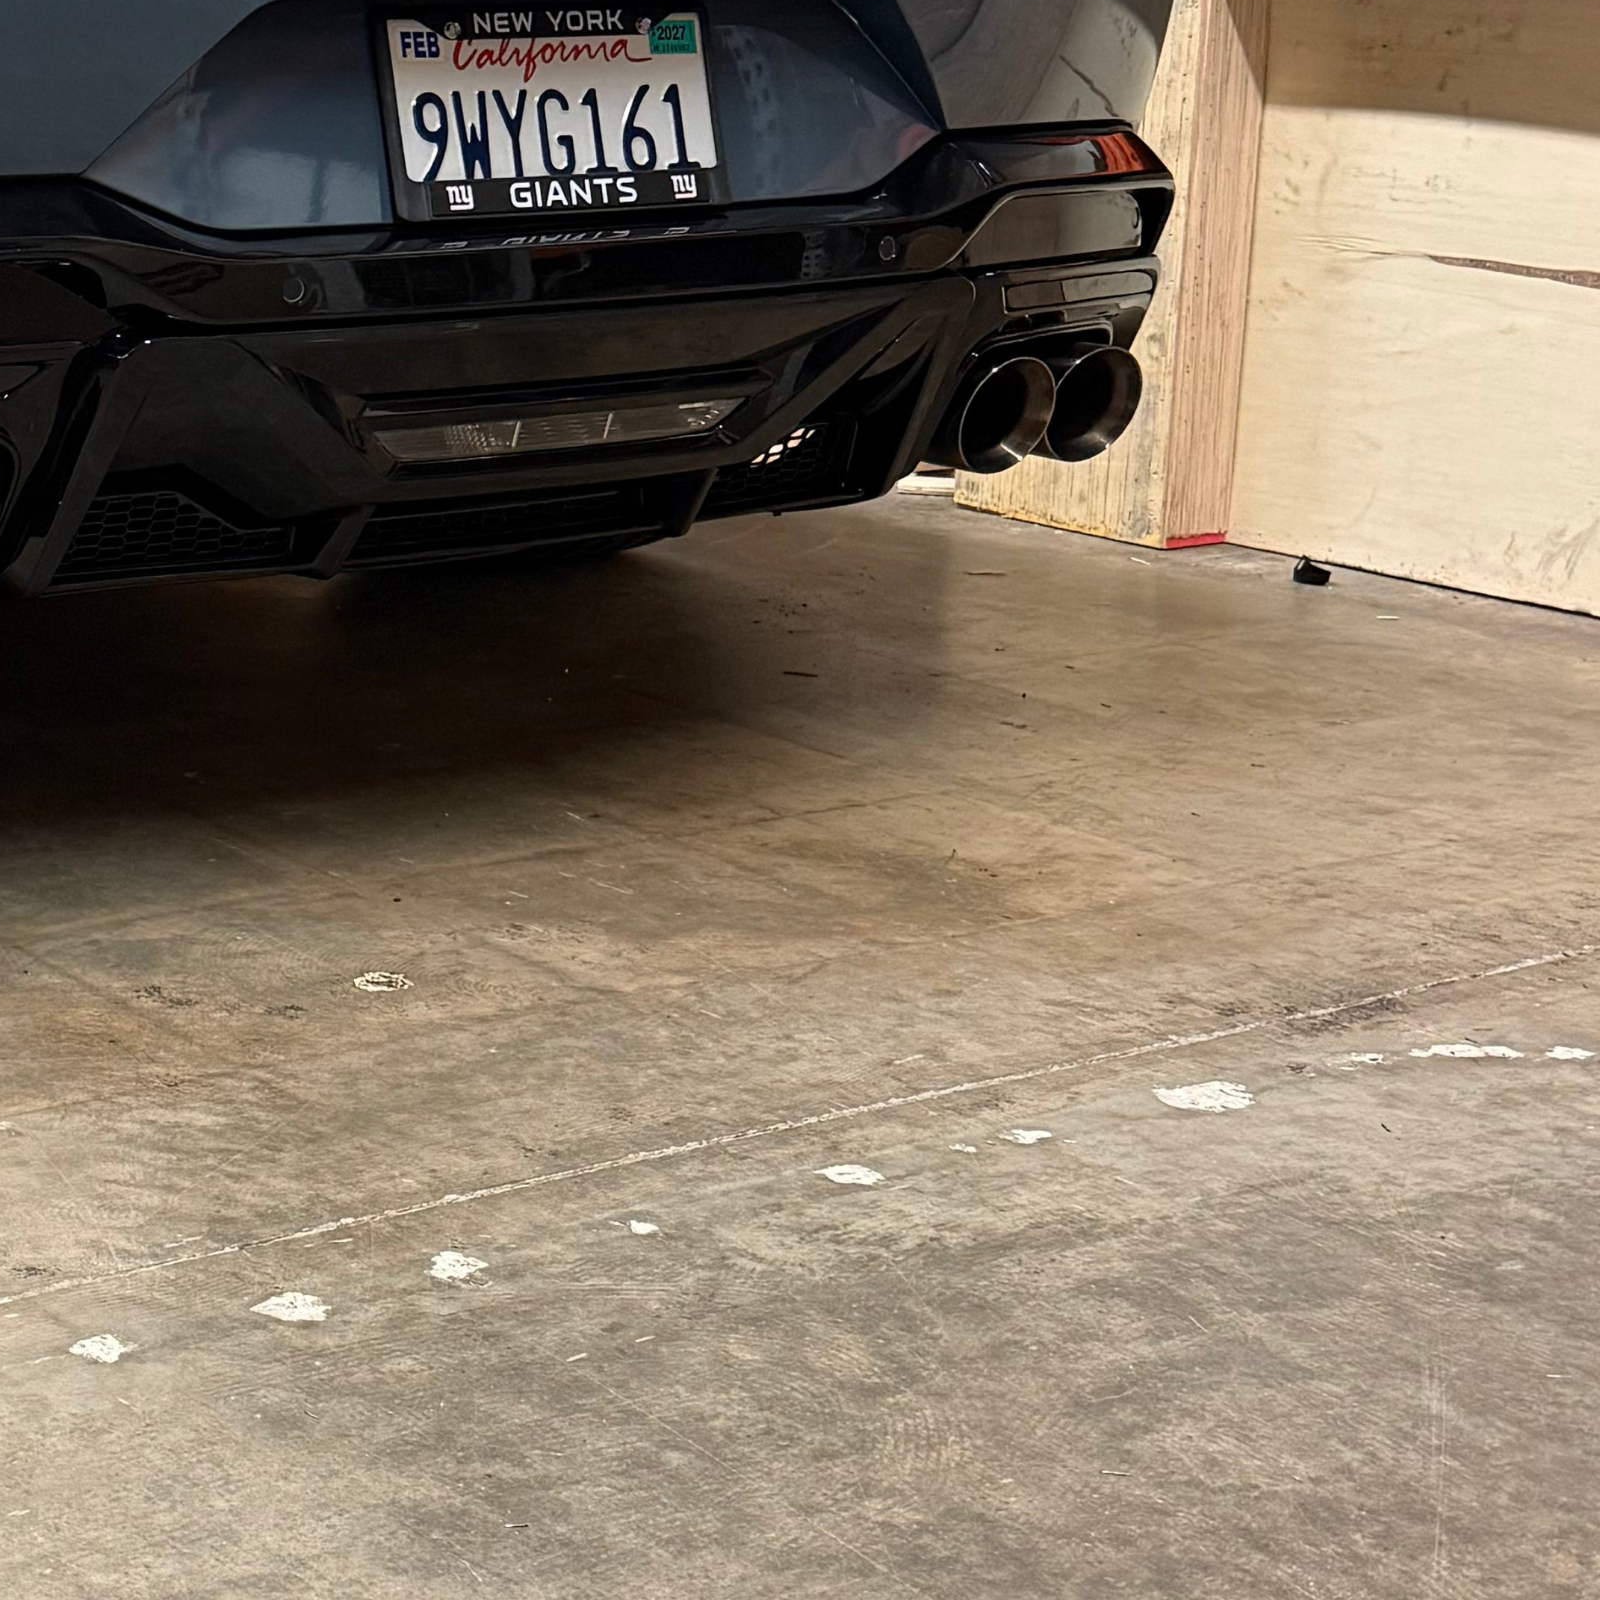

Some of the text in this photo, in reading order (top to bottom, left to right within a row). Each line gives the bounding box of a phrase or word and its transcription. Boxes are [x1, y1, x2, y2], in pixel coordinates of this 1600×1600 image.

[473, 9, 624, 34] NEW YORK
[656, 24, 686, 41] 2027
[400, 31, 440, 58] FEB
[453, 37, 652, 82] California
[412, 83, 700, 182] 9WYG161
[509, 176, 638, 208] GIANTS
